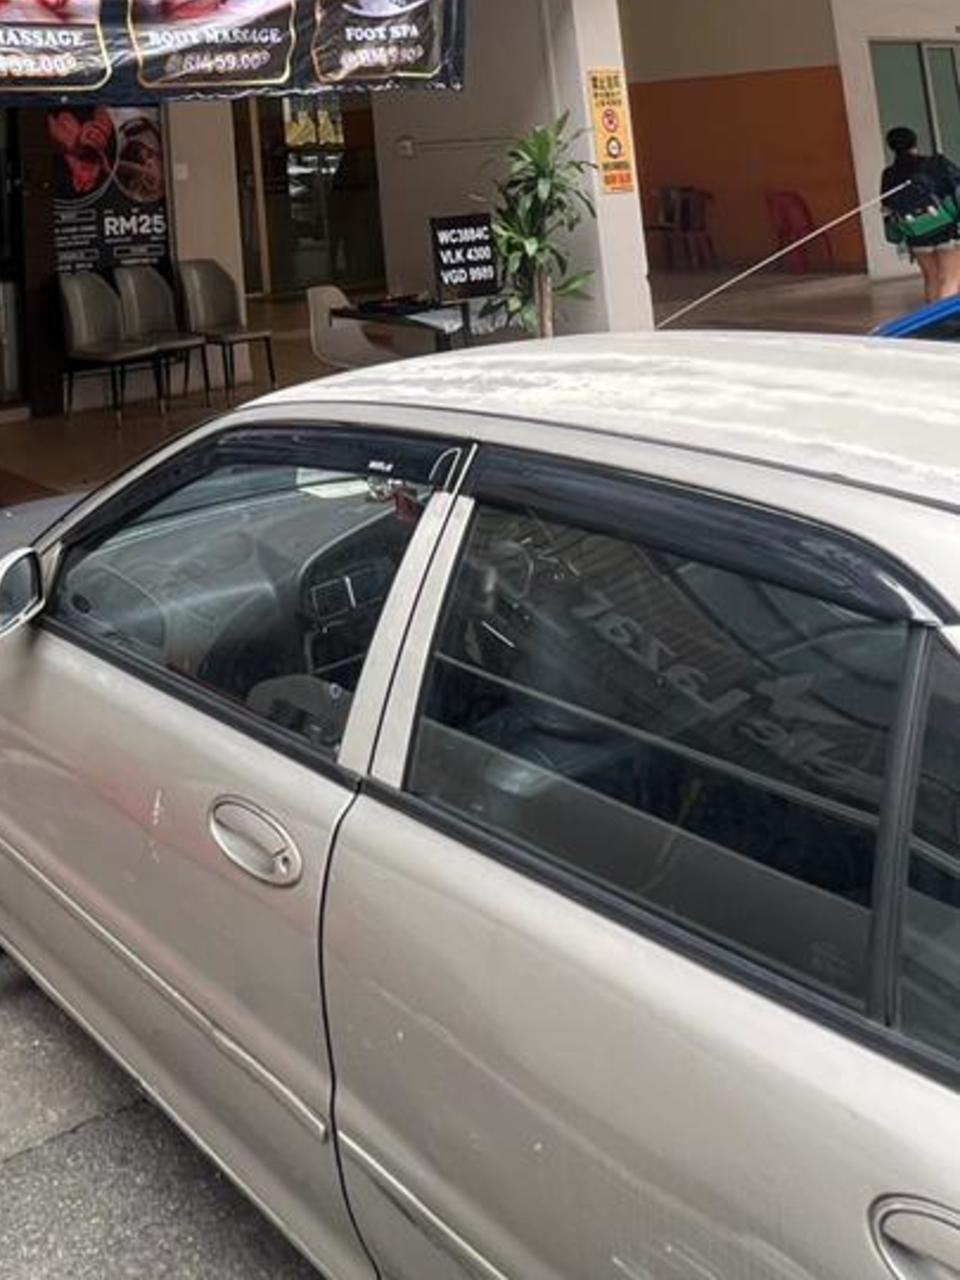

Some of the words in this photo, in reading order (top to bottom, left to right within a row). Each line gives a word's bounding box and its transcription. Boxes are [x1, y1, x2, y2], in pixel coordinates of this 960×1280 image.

[345, 26, 387, 41] FOOT
[103, 214, 167, 237] RM25
[440, 247, 466, 265] VLK
[440, 268, 468, 285] VGD
